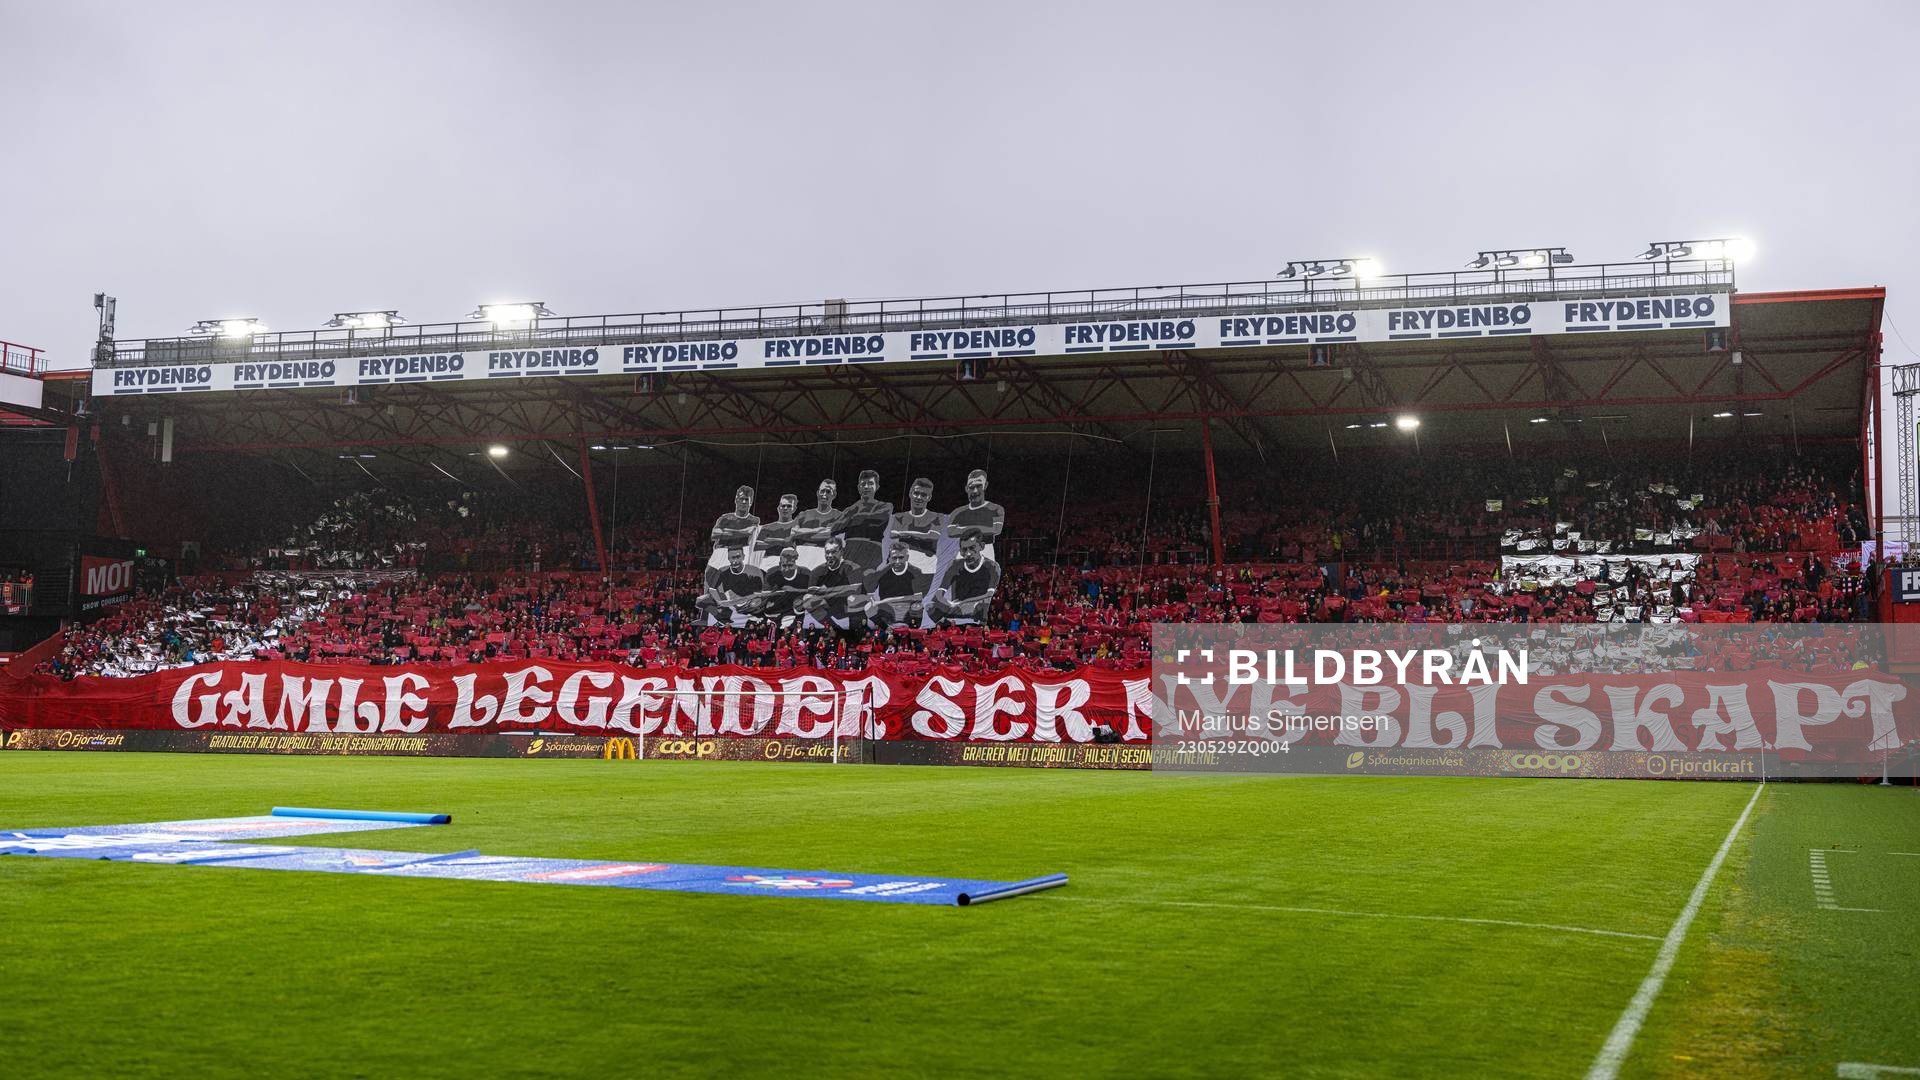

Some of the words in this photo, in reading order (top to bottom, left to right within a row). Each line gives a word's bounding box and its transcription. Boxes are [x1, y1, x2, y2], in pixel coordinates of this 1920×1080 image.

[1389, 304, 1532, 331] FRYDENBØ
[1565, 295, 1714, 322] FRYDENBØ
[1065, 321, 1196, 346] FRYDENBØ
[1220, 313, 1357, 338] FRYDENBØ
[764, 334, 885, 359] FRYDENBØ
[911, 328, 1036, 352] FRYDENBØ
[489, 348, 599, 370] FRYDENBØ
[623, 341, 738, 365] FRYDENBØ
[114, 366, 212, 387] FRYDENBØ
[234, 360, 336, 382] FRYDENBØ
[359, 354, 464, 377] FRYDENBØ
[87, 561, 135, 595] MOT
[172, 670, 430, 734] GAMLE
[448, 666, 891, 740] LEGENDER
[911, 675, 1098, 743] SER
[1122, 673, 1310, 743] NYE
[1334, 680, 1504, 751] BLI
[1533, 679, 1907, 754] SKAPT
[209, 735, 262, 748] GRATULERER
[260, 737, 278, 749] MED
[277, 737, 315, 749] CUPGULL!
[321, 738, 350, 750] HILSEN
[350, 738, 429, 751] SESONGPARTNERNE:
[963, 746, 1006, 761] GRAERER
[1007, 747, 1029, 762] MED
[1031, 747, 1077, 763] CUPGULL!
[1084, 748, 1119, 764] HILSEN
[1368, 755, 1463, 768] SparebankenVest
[1670, 759, 1754, 775] Fjordkraft
